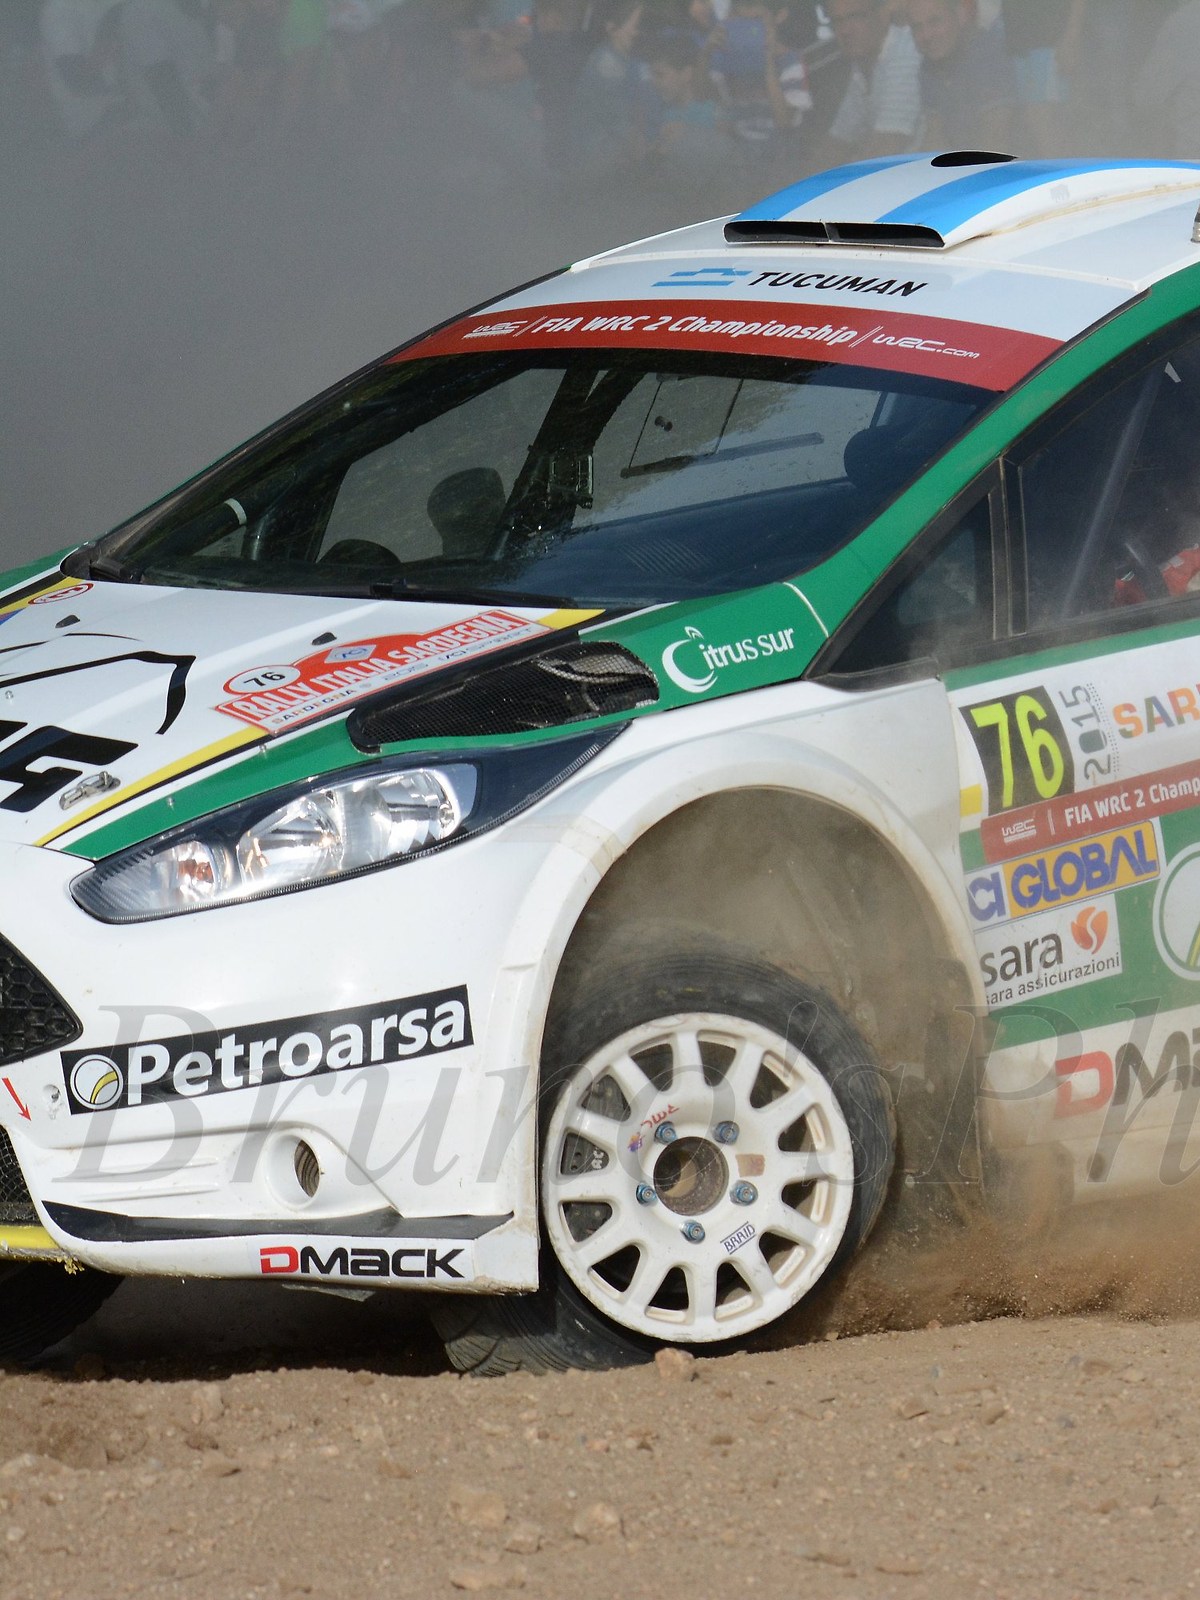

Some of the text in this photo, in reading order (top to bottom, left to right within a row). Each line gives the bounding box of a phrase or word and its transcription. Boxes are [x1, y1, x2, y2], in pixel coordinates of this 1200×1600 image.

[748, 272, 928, 297] TUCUMAN
[531, 317, 584, 334] FIA
[581, 316, 650, 332] WRC
[643, 316, 673, 331] 2
[668, 316, 858, 346] Championship
[232, 681, 322, 718] RALLY
[310, 658, 402, 691] ITALIA
[387, 614, 522, 664] SARDEGNA
[243, 671, 286, 687] 76
[661, 628, 795, 693] Citrus sur
[970, 694, 1064, 809] 76
[1058, 684, 1112, 781] 2015
[1064, 803, 1093, 828] FIA
[1094, 793, 1132, 819] WRC
[1136, 788, 1147, 808] 2
[1010, 830, 1159, 909] GLOBAL
[980, 932, 1063, 988] sara
[1018, 952, 1120, 996] assicurazioni
[127, 999, 465, 1106] Petroarsa
[260, 1246, 465, 1278] DMACK
[723, 1223, 756, 1253] BRAID
